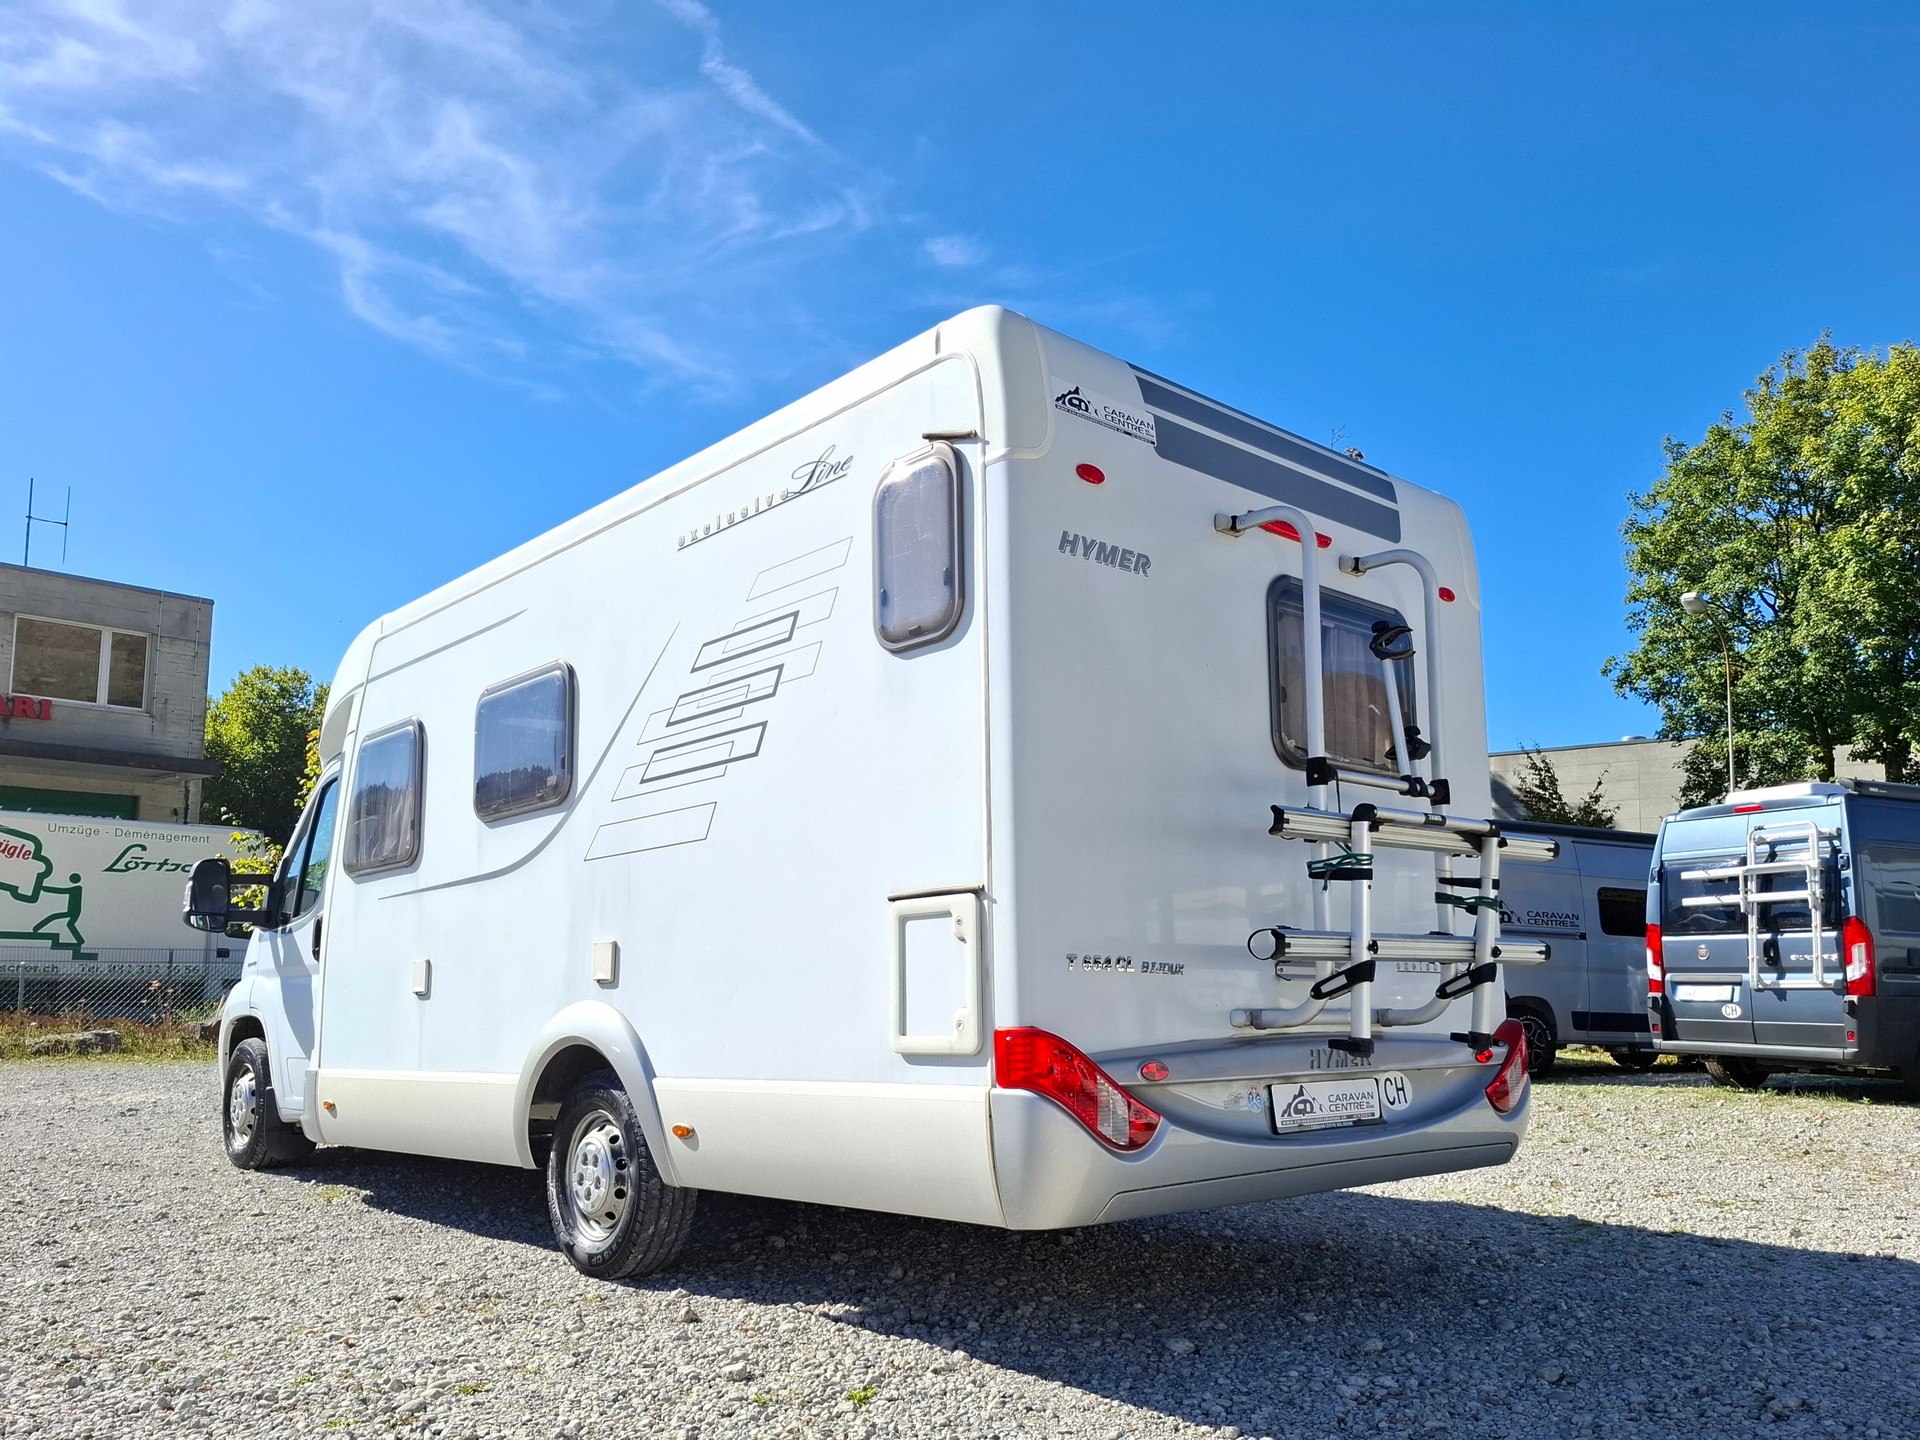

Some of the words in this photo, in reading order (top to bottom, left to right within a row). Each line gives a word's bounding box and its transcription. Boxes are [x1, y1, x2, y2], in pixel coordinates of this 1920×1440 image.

[1103, 405, 1154, 431] CARAVAN
[1104, 413, 1145, 435] CENTRE
[788, 444, 854, 496] Line
[1058, 529, 1152, 578] HYMER
[47, 822, 100, 837] Umzüge
[114, 827, 210, 844] Déménagement
[1526, 910, 1579, 921] CARAVAN
[1527, 918, 1570, 928] CENTRE
[1065, 953, 1078, 971] T
[1082, 954, 1112, 972] 654
[1115, 955, 1136, 973] CL
[1724, 1005, 1738, 1016] CH
[1328, 1091, 1374, 1103] CARAVAN
[1383, 1076, 1408, 1106] CH
[1328, 1101, 1366, 1113] CENTRE
